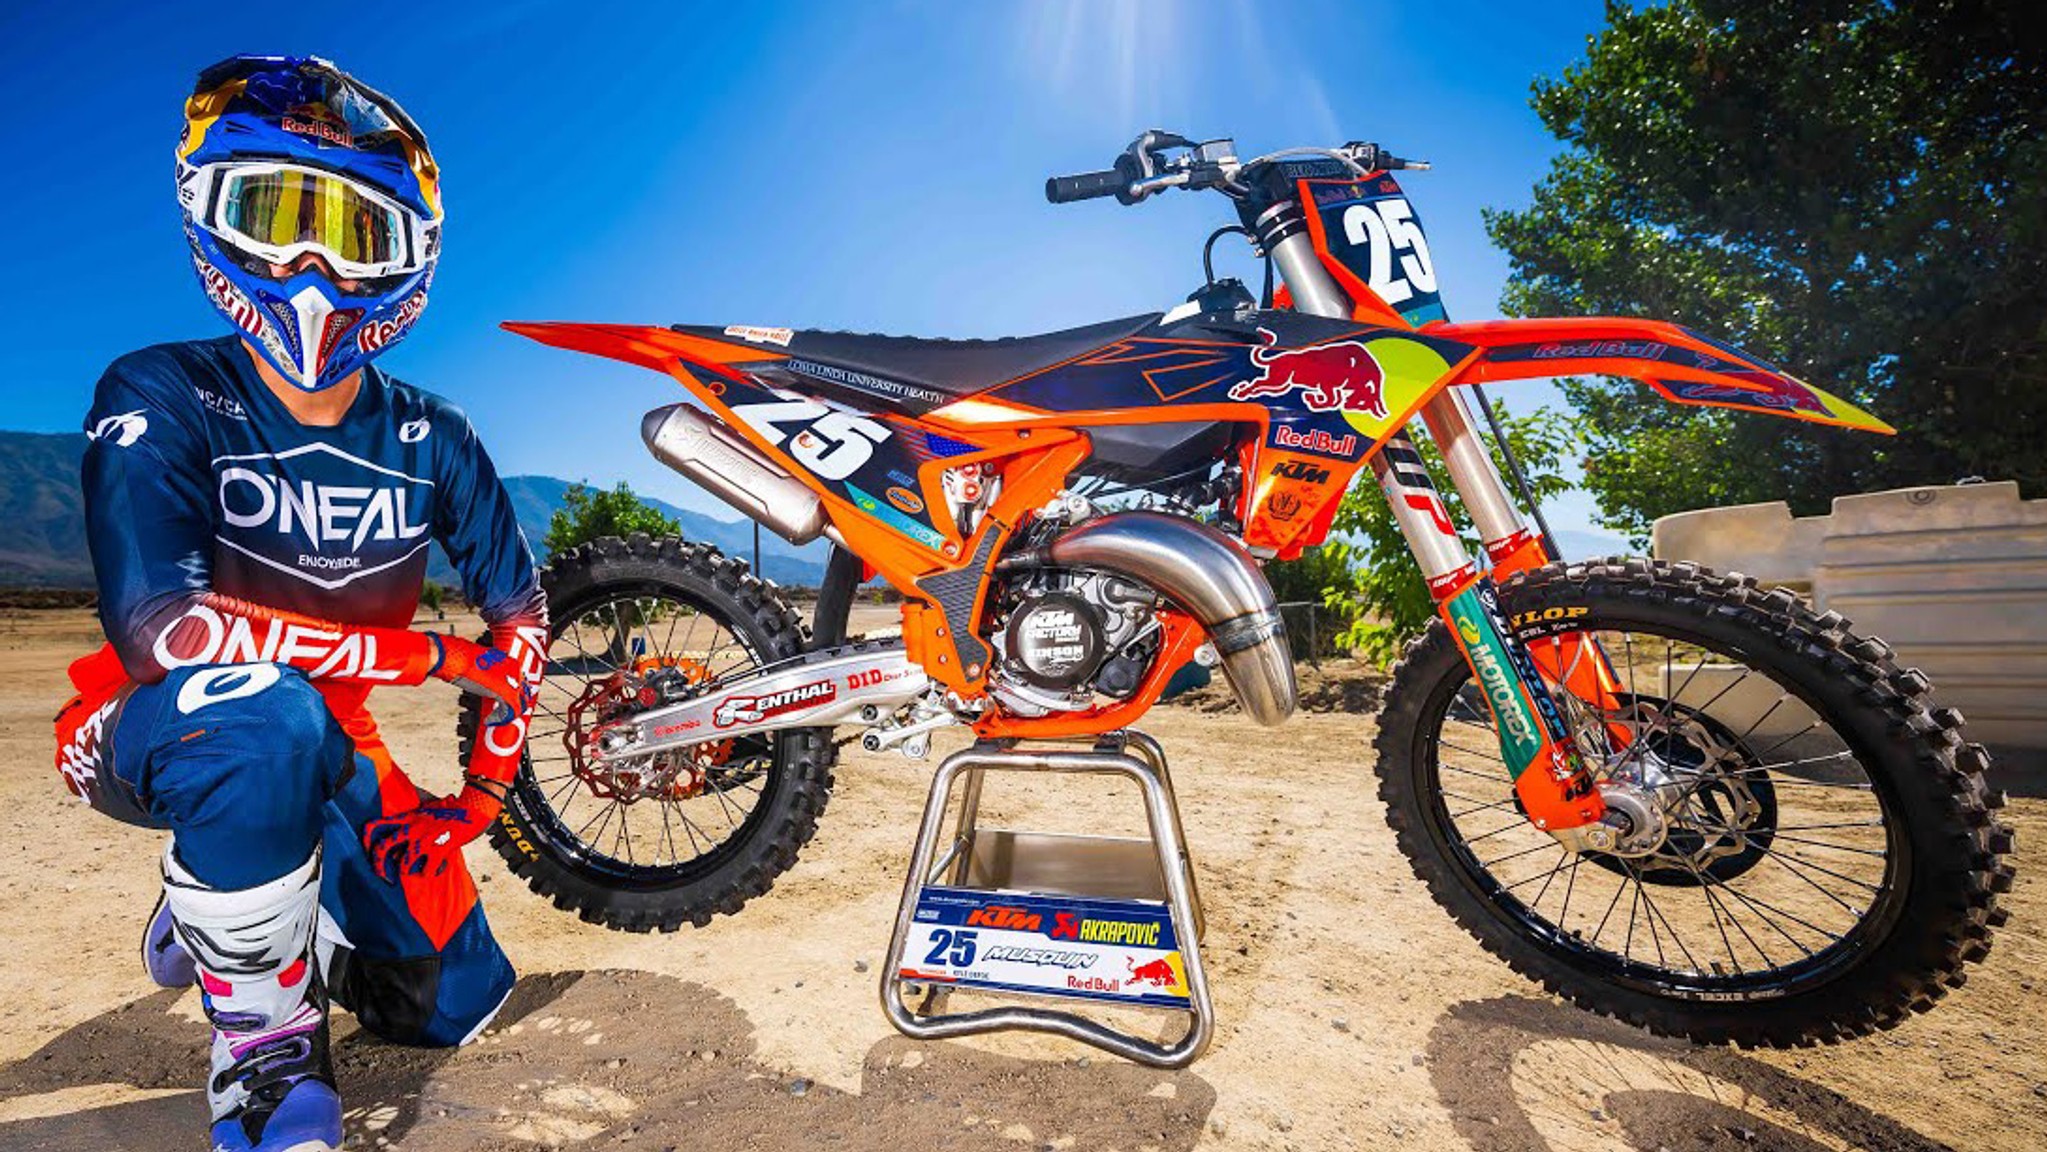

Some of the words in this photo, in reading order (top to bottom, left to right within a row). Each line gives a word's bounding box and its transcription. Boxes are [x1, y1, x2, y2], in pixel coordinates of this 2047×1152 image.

[282, 117, 318, 136] Red
[319, 123, 354, 149] Bull
[1343, 199, 1438, 305] 25
[1533, 341, 1602, 358] Red
[1599, 341, 1668, 360] Bull
[817, 362, 846, 381] LINDA
[847, 372, 902, 394] UNIVERSITY
[904, 385, 945, 404] HEALTH
[729, 388, 893, 480] 25
[1276, 425, 1317, 449] Red
[1315, 431, 1356, 456] Bull
[1271, 460, 1330, 484] KTM
[717, 682, 834, 726] RENTHAL
[1471, 643, 1537, 747] MOTOREX
[966, 905, 1042, 930] KTM
[924, 928, 978, 967] 25
[982, 946, 1099, 969] MUSQUIN
[1067, 975, 1093, 990] Red
[1094, 977, 1119, 992] Bull
[1696, 992, 1744, 1002] EXCEL
